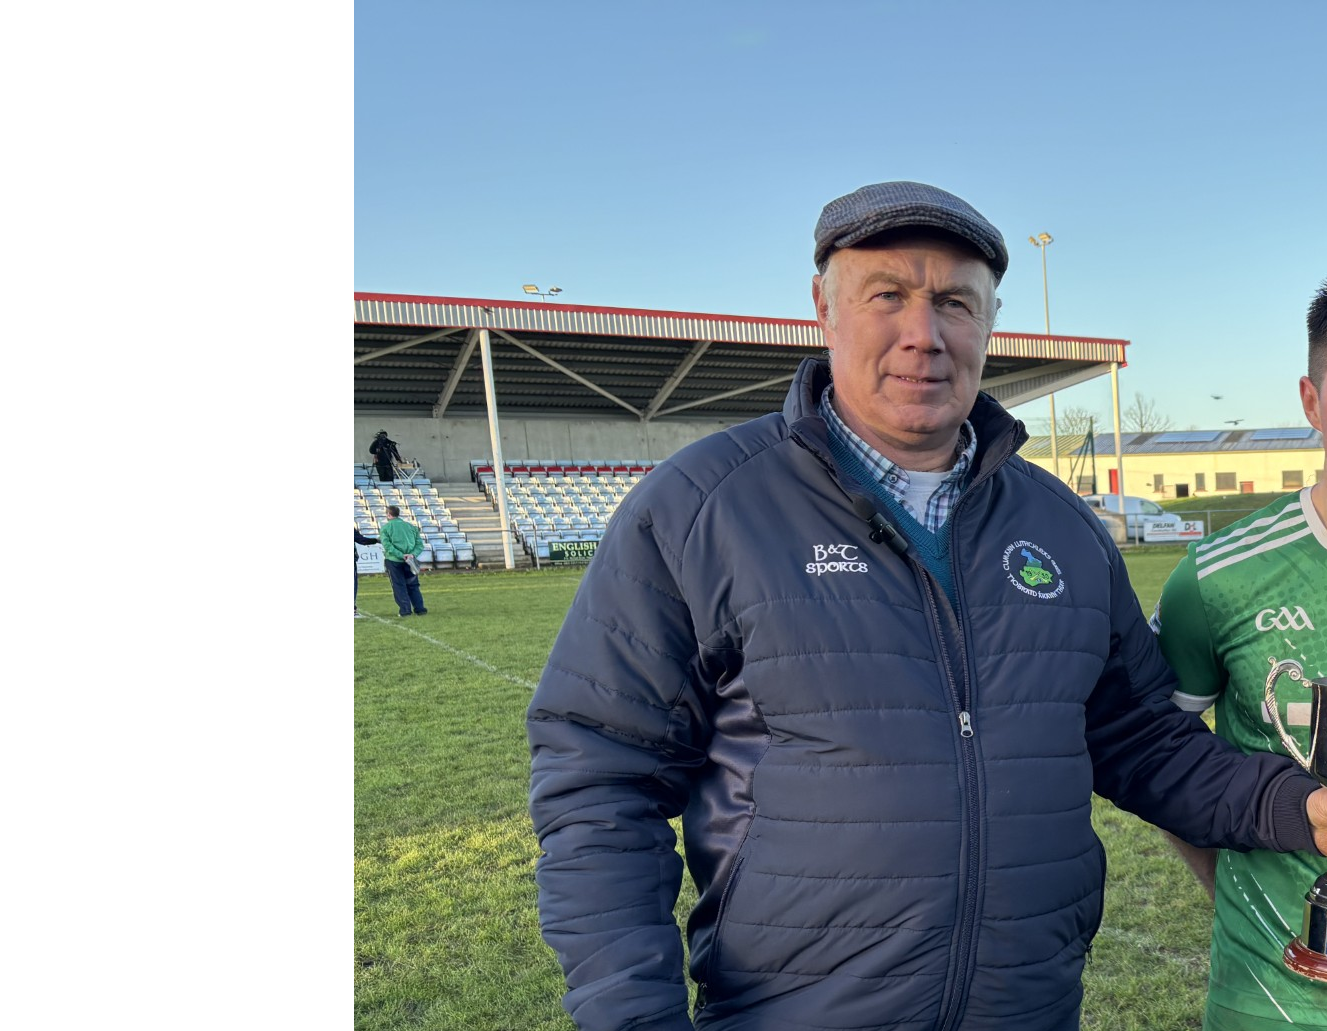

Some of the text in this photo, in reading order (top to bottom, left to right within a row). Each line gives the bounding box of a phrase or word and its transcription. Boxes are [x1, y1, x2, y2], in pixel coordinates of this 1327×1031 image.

[552, 541, 597, 552] ENGLISH
[812, 543, 859, 562] B&T
[1255, 605, 1315, 632] GAA
